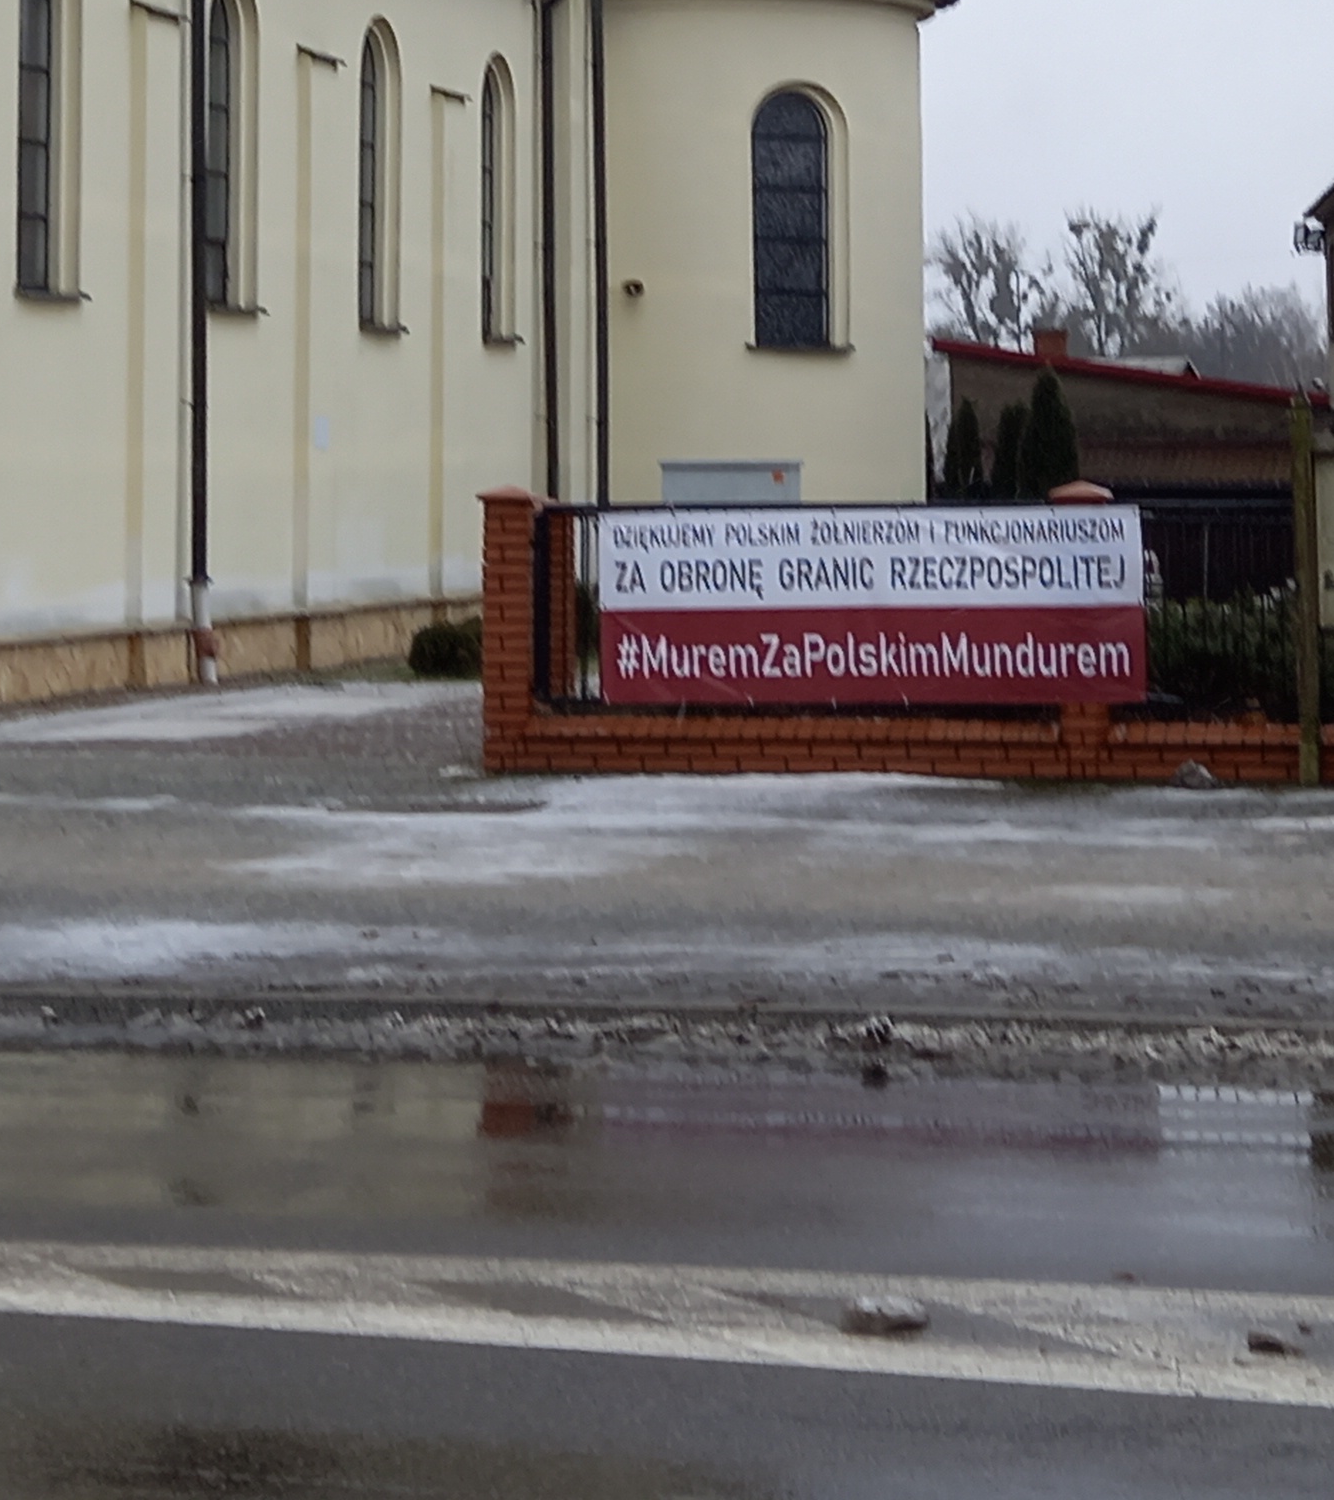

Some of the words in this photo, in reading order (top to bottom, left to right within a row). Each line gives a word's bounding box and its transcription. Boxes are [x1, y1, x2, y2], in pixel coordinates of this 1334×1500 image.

[613, 523, 715, 554] DZIĘKUJEMY
[725, 522, 801, 547] POLSKIM
[929, 520, 936, 544] I
[944, 518, 1126, 545] FUNKCJONARIUSZOM
[614, 559, 647, 594] ZA
[659, 557, 765, 600] OBRONĘ
[778, 555, 875, 593] GRANIC
[890, 554, 1126, 592] RZECZPOSPOLITEJ
[615, 631, 1132, 680] #MuremZaPolskimMundurem
